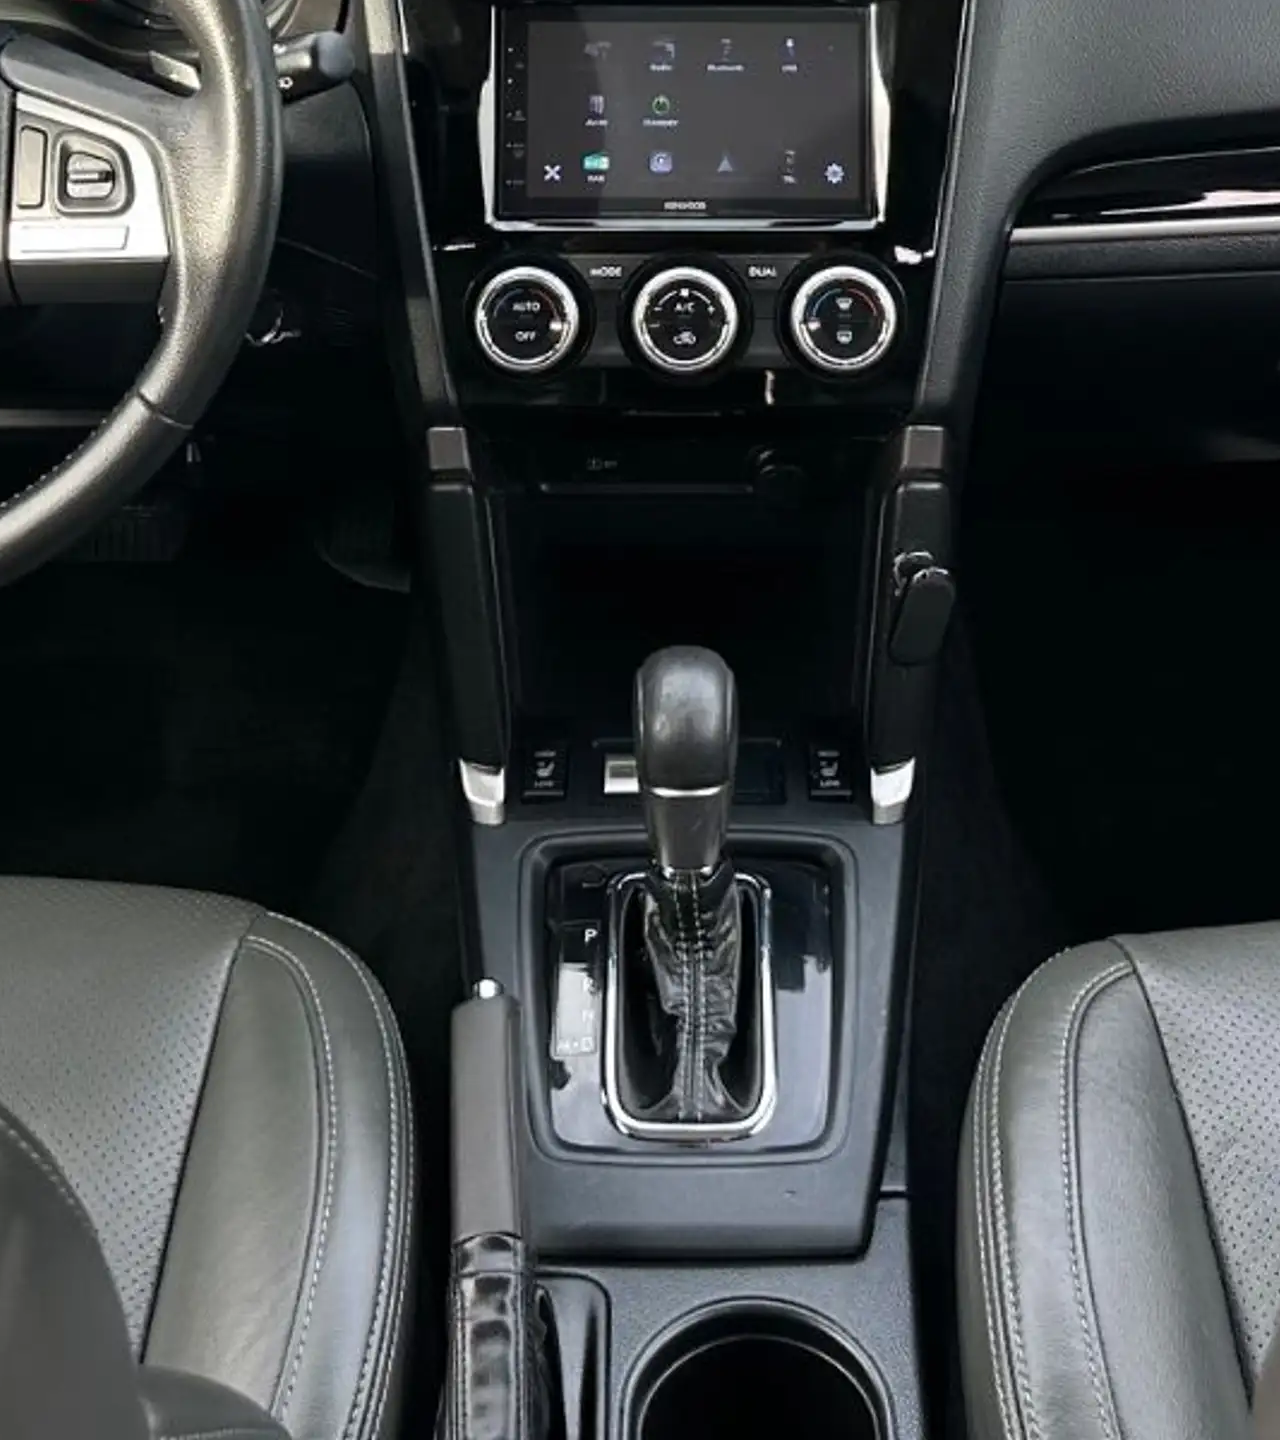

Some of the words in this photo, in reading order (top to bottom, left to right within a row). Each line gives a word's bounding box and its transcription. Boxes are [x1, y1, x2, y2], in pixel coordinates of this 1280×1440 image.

[590, 266, 621, 276] MODE
[748, 266, 777, 277] DUAL
[513, 301, 541, 311] AUTO
[675, 302, 695, 312] A/C
[515, 331, 536, 341] OFF
[584, 928, 598, 943] P
